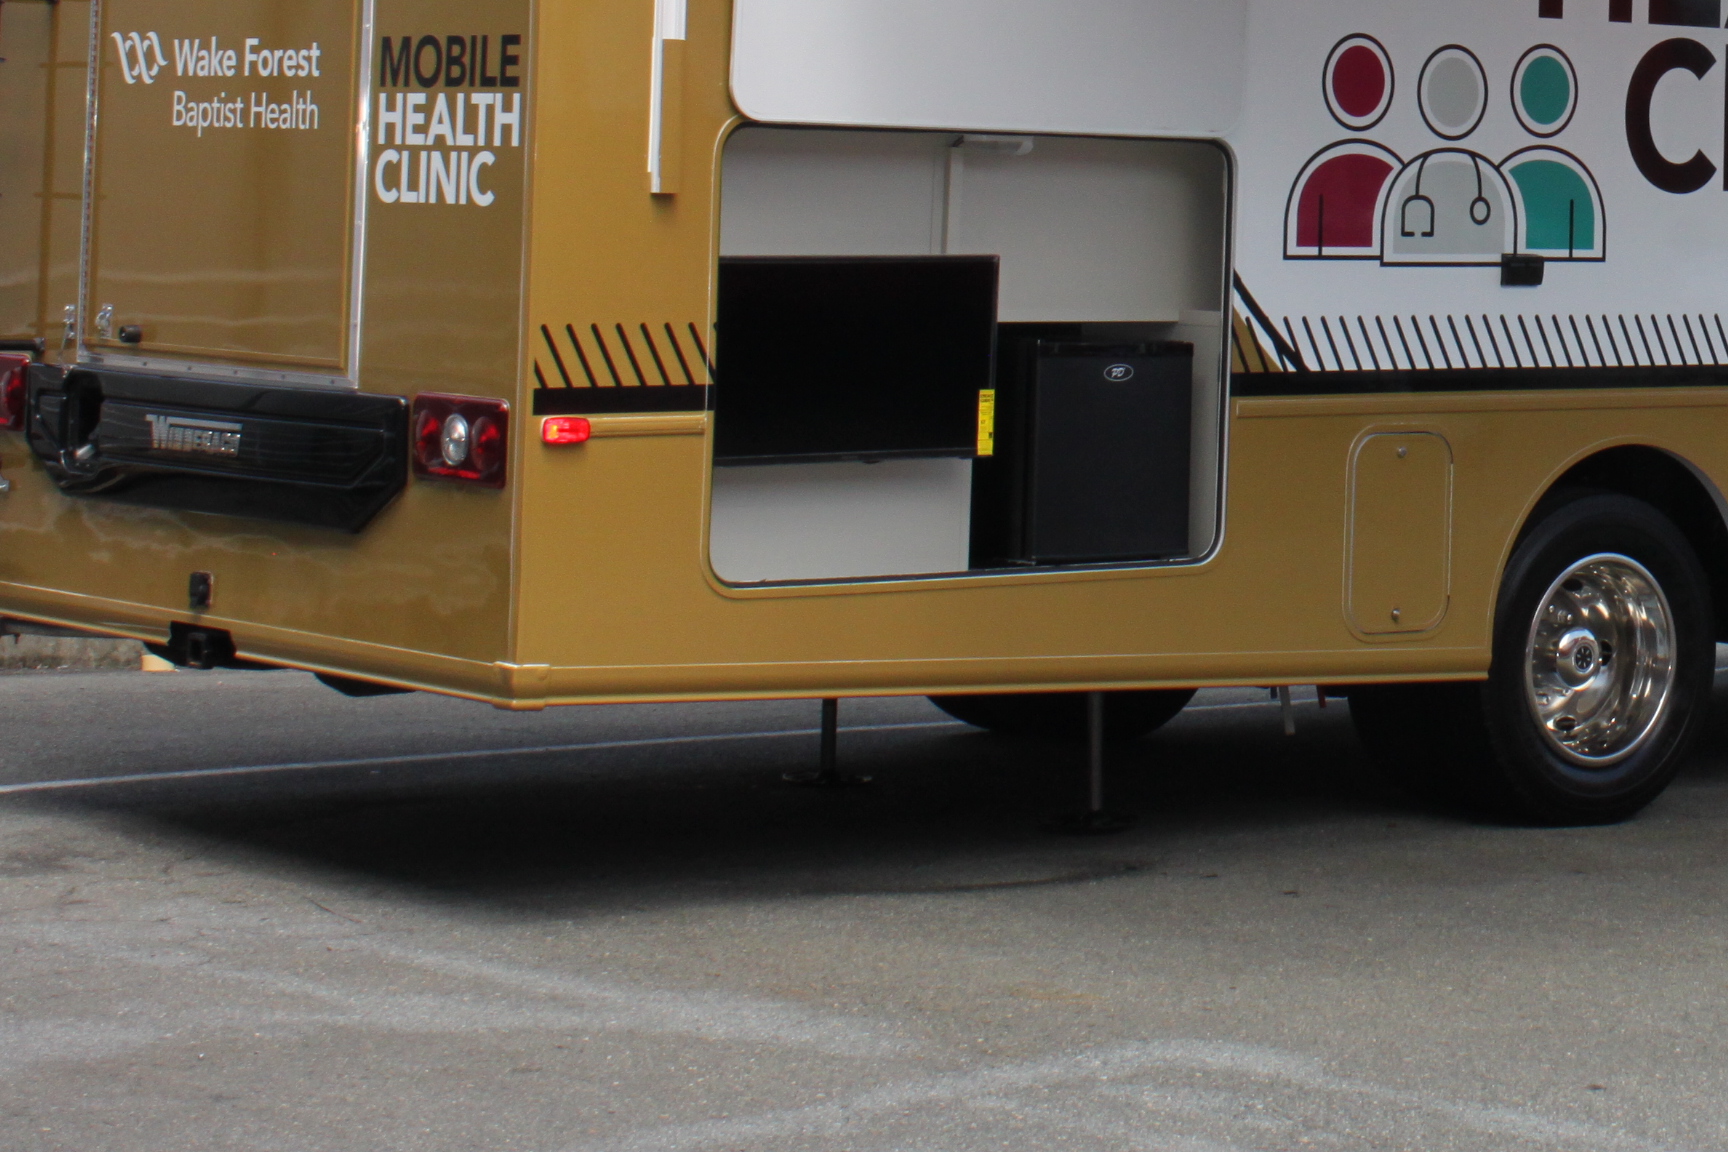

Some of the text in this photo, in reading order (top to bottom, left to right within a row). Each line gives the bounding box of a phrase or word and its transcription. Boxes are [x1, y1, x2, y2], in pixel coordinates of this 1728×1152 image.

[174, 36, 321, 77] Wake Forest
[379, 34, 521, 88] MOBILE
[172, 90, 319, 137] Baptist Health
[377, 92, 521, 147] HEALTH
[375, 148, 496, 207] CLINIC
